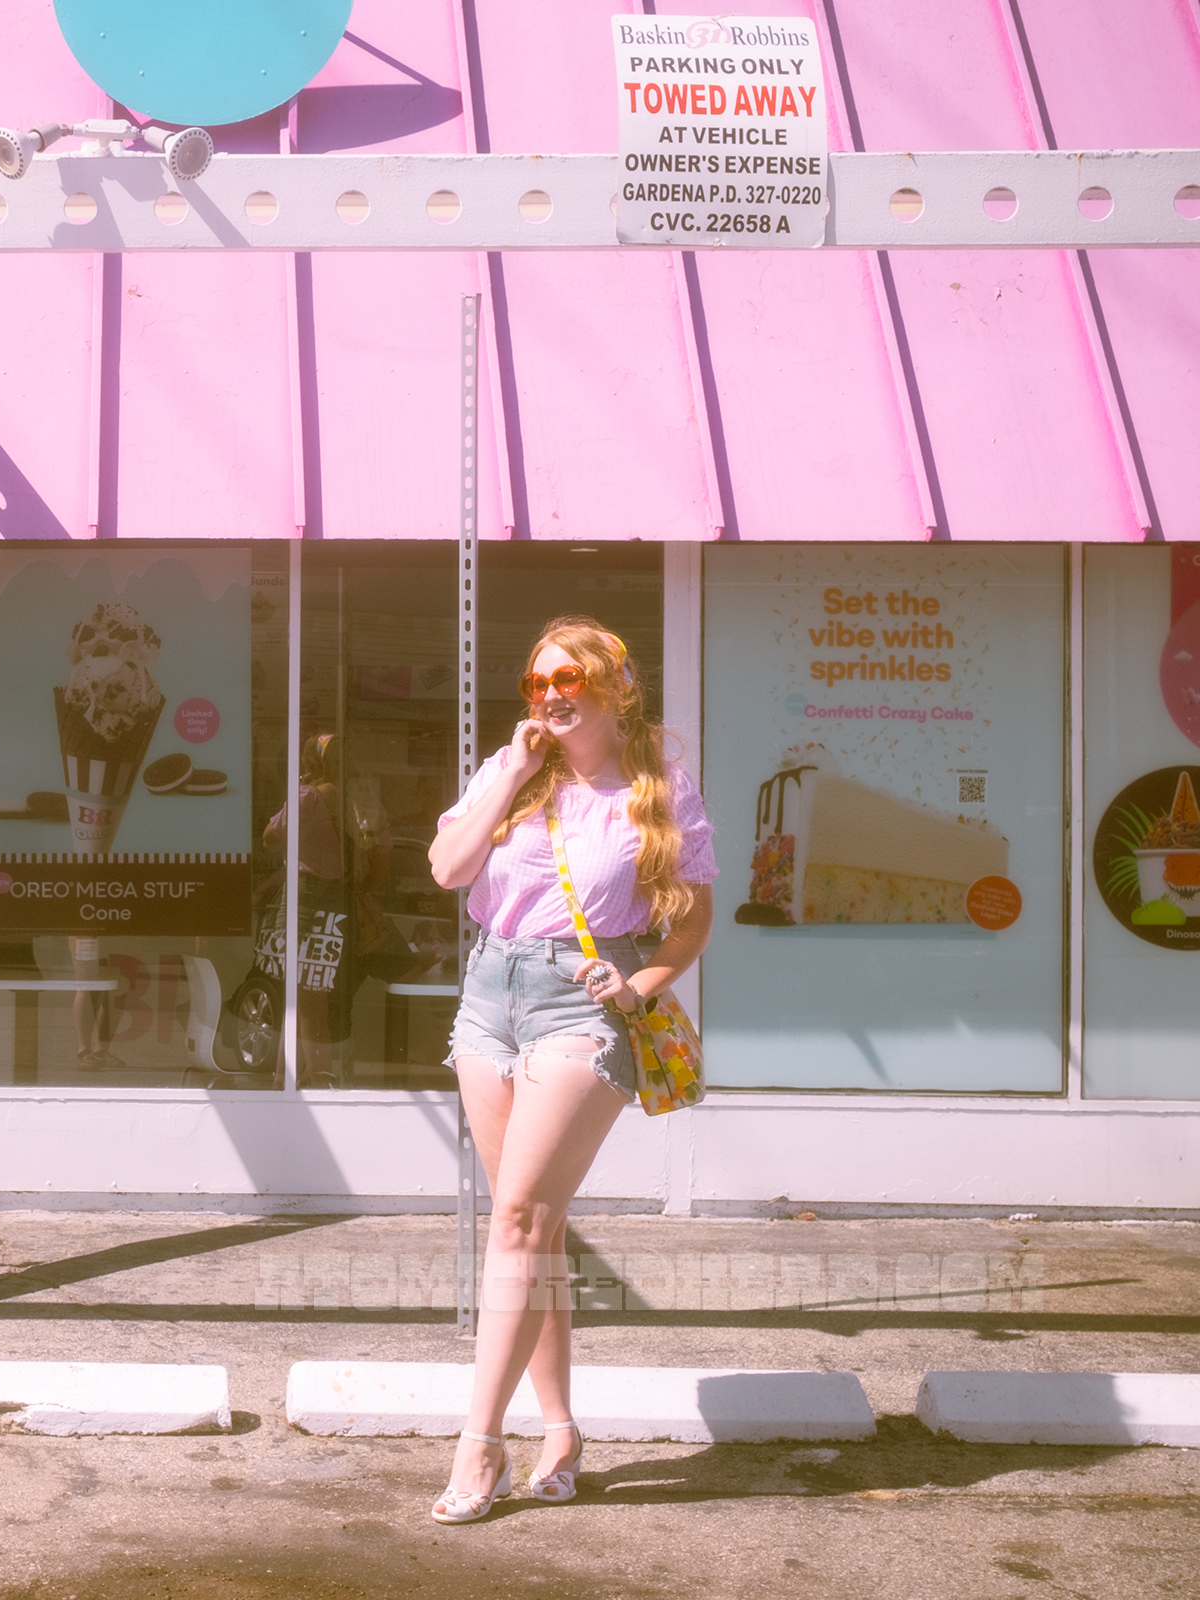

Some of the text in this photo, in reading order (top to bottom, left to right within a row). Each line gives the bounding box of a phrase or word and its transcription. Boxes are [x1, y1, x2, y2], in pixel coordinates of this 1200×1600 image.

[619, 24, 686, 45] Baskin
[730, 25, 810, 47] Robbins
[630, 57, 804, 75] PARKING ONLY
[624, 82, 817, 117] TOWED AWAY
[658, 126, 788, 145] AT VEHICLE
[625, 153, 821, 175] OWNER'S EXPENSE
[623, 183, 822, 205] GARDENA P.D. 327-0220
[650, 212, 791, 234] CVC. 22658 A
[823, 587, 941, 617] Set the
[808, 620, 954, 649] vibe with
[810, 654, 952, 687] sprinkles
[181, 709, 213, 718] Limited
[187, 718, 207, 726] time
[804, 704, 974, 723] Confetti Crazy Cake
[186, 726, 208, 736] only!
[76, 881, 138, 898] MEGA
[79, 904, 132, 921] Cone
